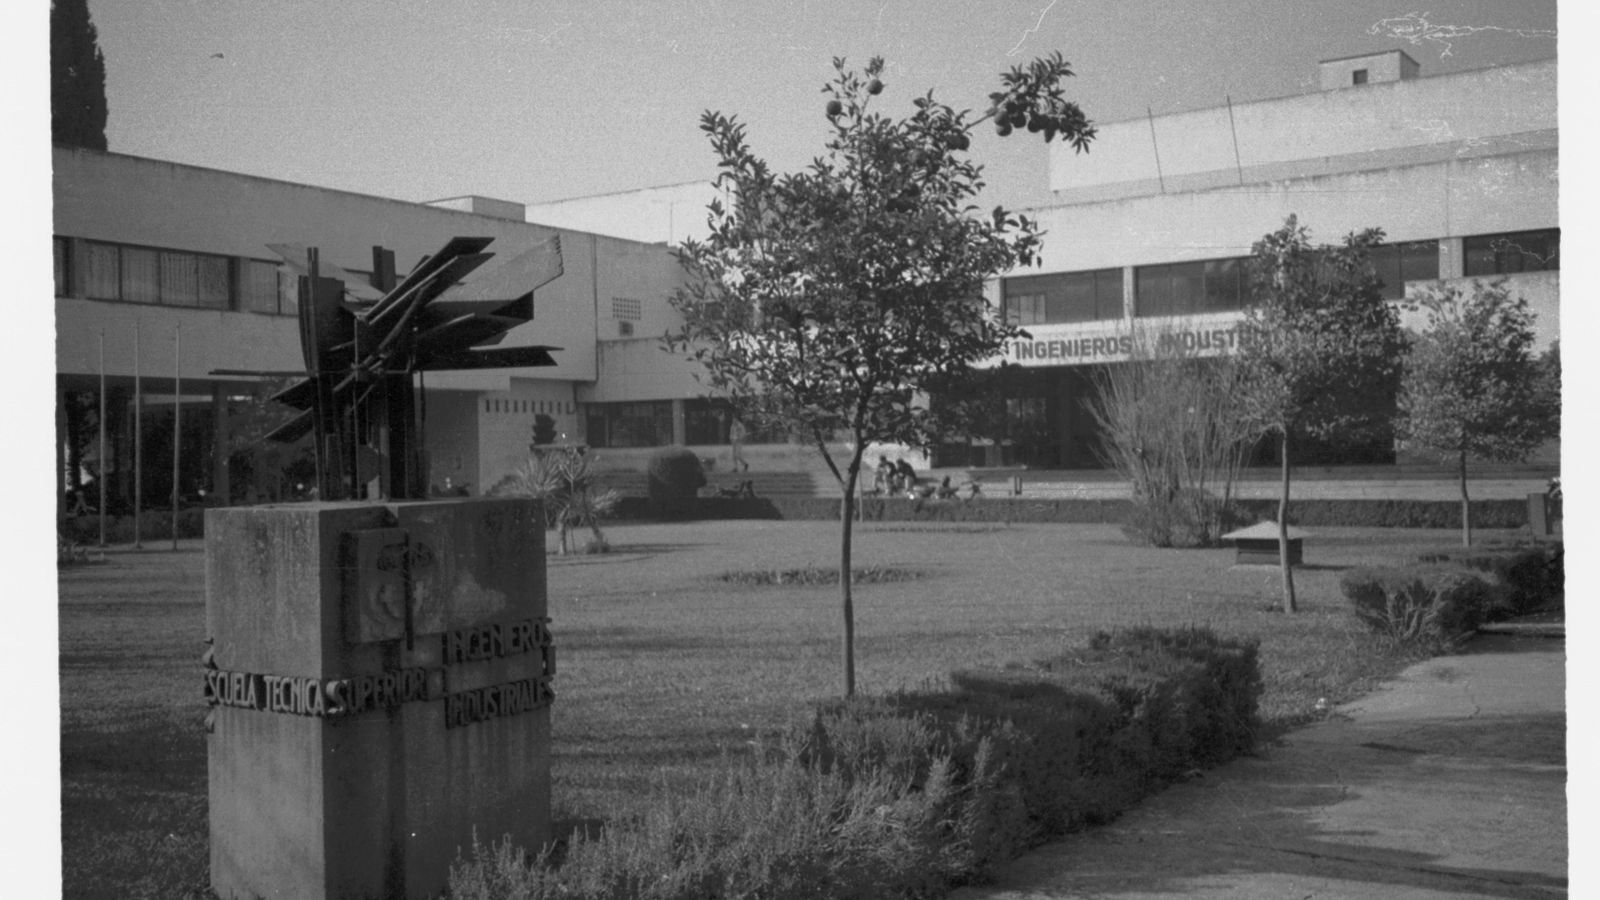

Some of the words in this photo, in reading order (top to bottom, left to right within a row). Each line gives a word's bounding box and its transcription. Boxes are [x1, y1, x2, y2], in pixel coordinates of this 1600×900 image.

[1012, 335, 1133, 359] INGENIEROS
[443, 617, 552, 665] INGENIEROS
[264, 675, 325, 715] TECNICA
[325, 667, 427, 714] SUPERIOR
[446, 677, 555, 728] INDUSTRIALES
